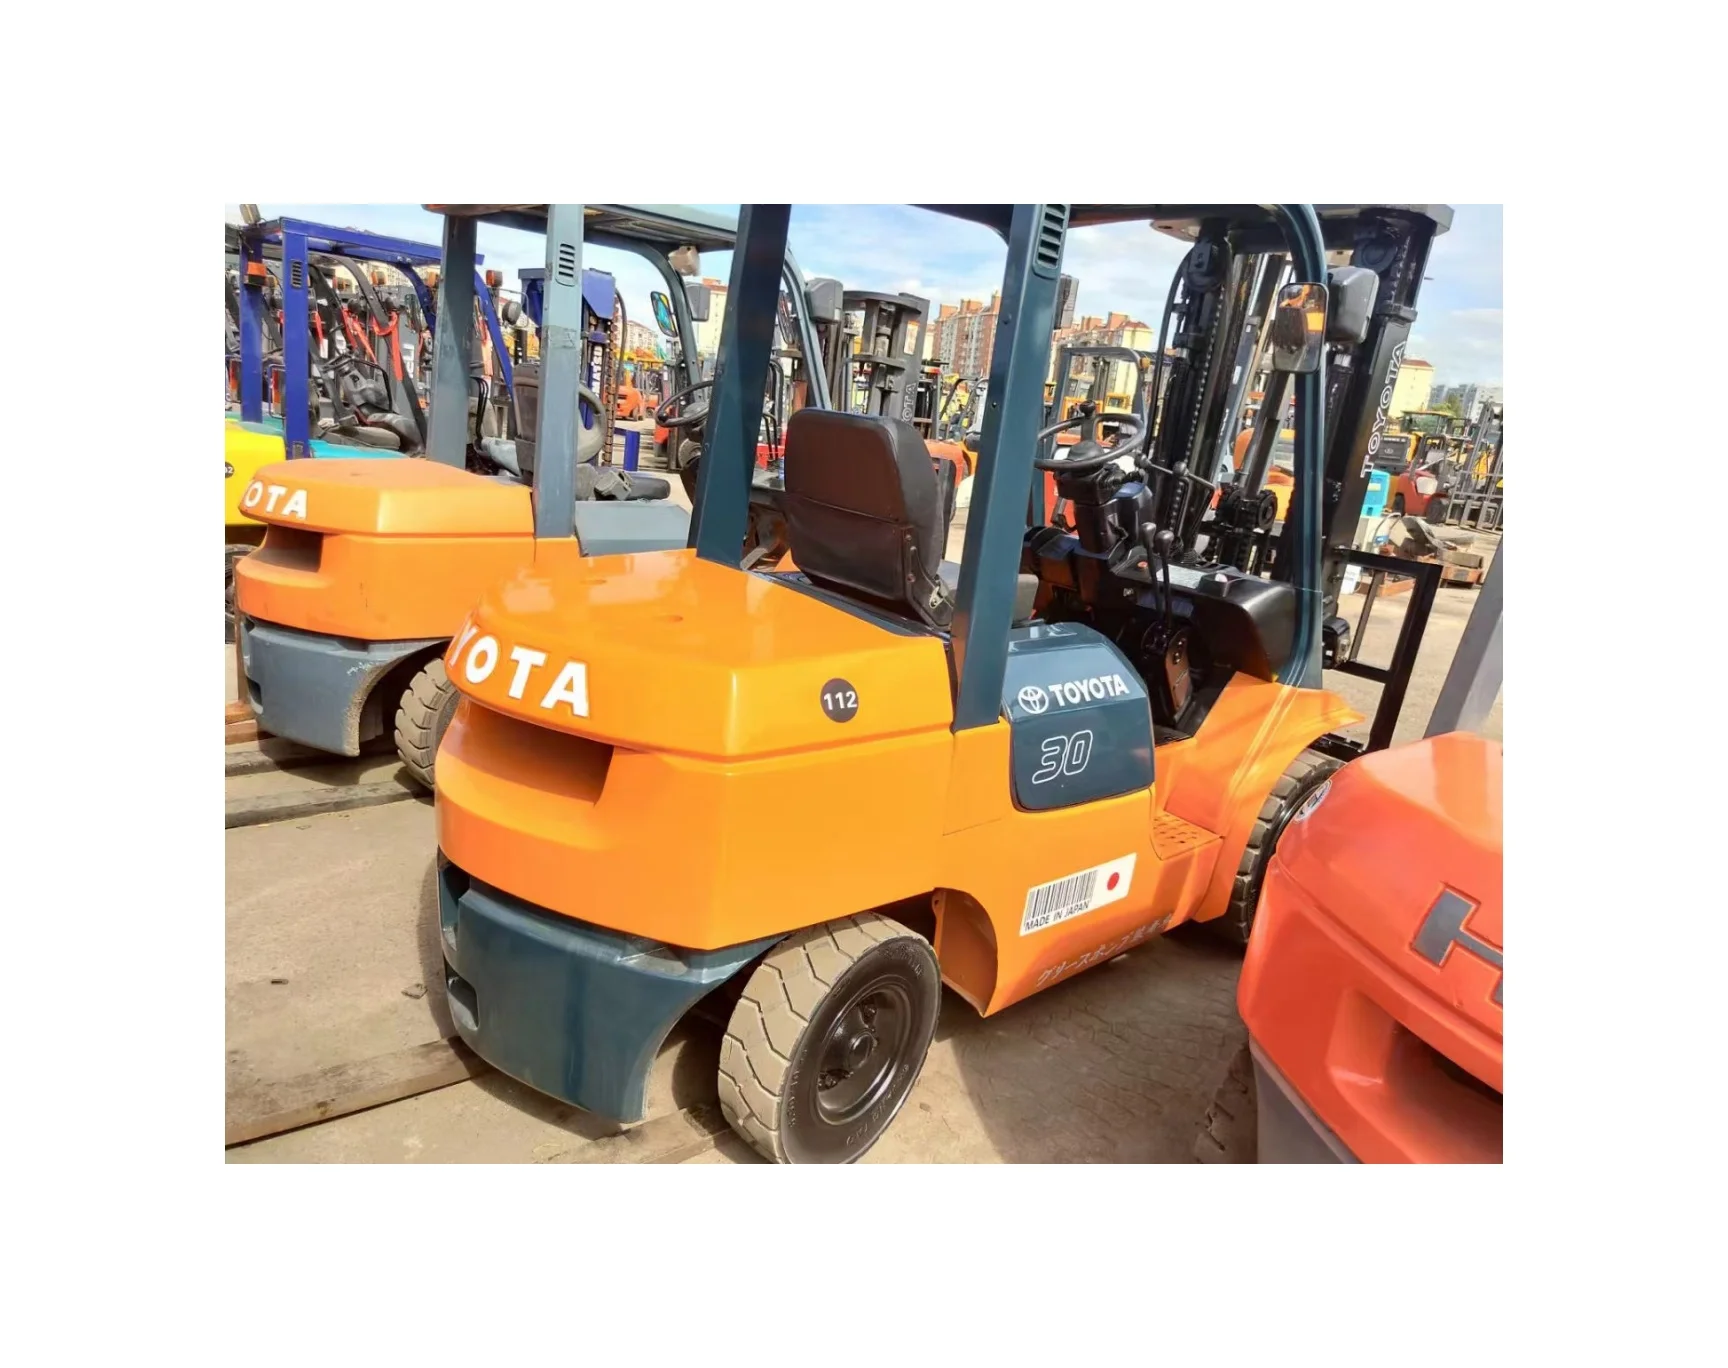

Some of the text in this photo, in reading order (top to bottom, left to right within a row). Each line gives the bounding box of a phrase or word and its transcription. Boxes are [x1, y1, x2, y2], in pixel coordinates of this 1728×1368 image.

[1360, 341, 1406, 478] TOYOTA
[449, 616, 590, 717] YOTA
[824, 691, 857, 710] 112
[1048, 674, 1130, 706] TOYOTA
[1031, 730, 1093, 785] 30
[1024, 900, 1090, 932] MADE IN JAPAN
